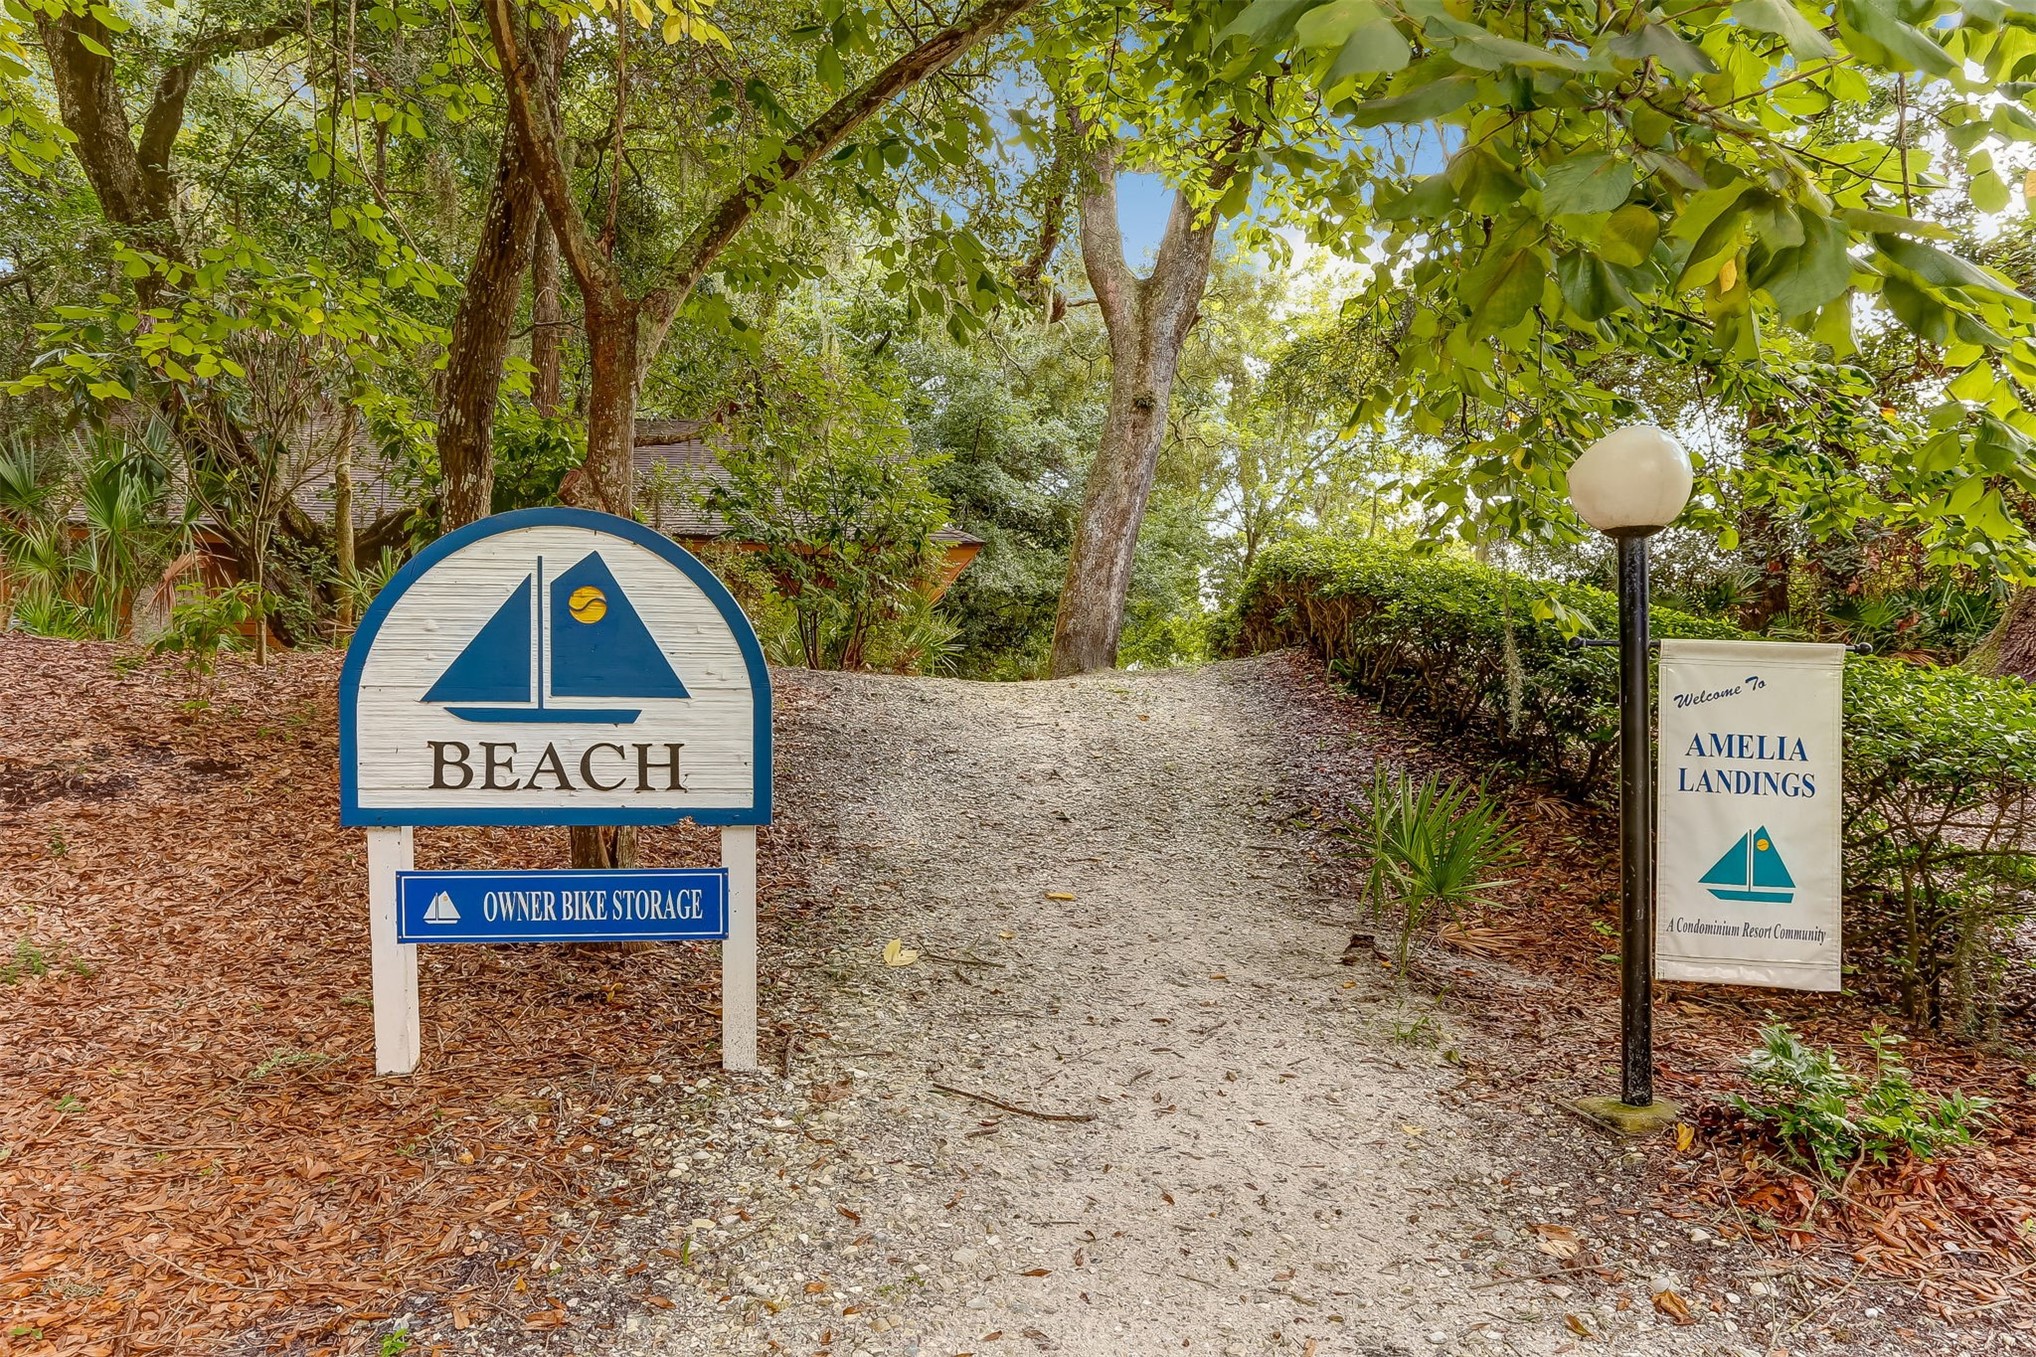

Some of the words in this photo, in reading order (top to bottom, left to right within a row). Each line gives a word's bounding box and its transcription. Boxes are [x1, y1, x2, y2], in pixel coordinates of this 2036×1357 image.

[1673, 685, 1742, 708] Welcome
[1745, 676, 1766, 691] To
[1685, 733, 1808, 762] AMELIA
[427, 740, 685, 791] BEACH
[1678, 768, 1815, 798] LANDINGS
[483, 890, 558, 922] OWNER
[561, 890, 608, 921] BIKE
[612, 889, 703, 920] STORAGE
[1666, 918, 1675, 932] A
[1676, 917, 1740, 937] Condominium
[1742, 923, 1772, 939] Resort
[1773, 924, 1826, 945] Community
